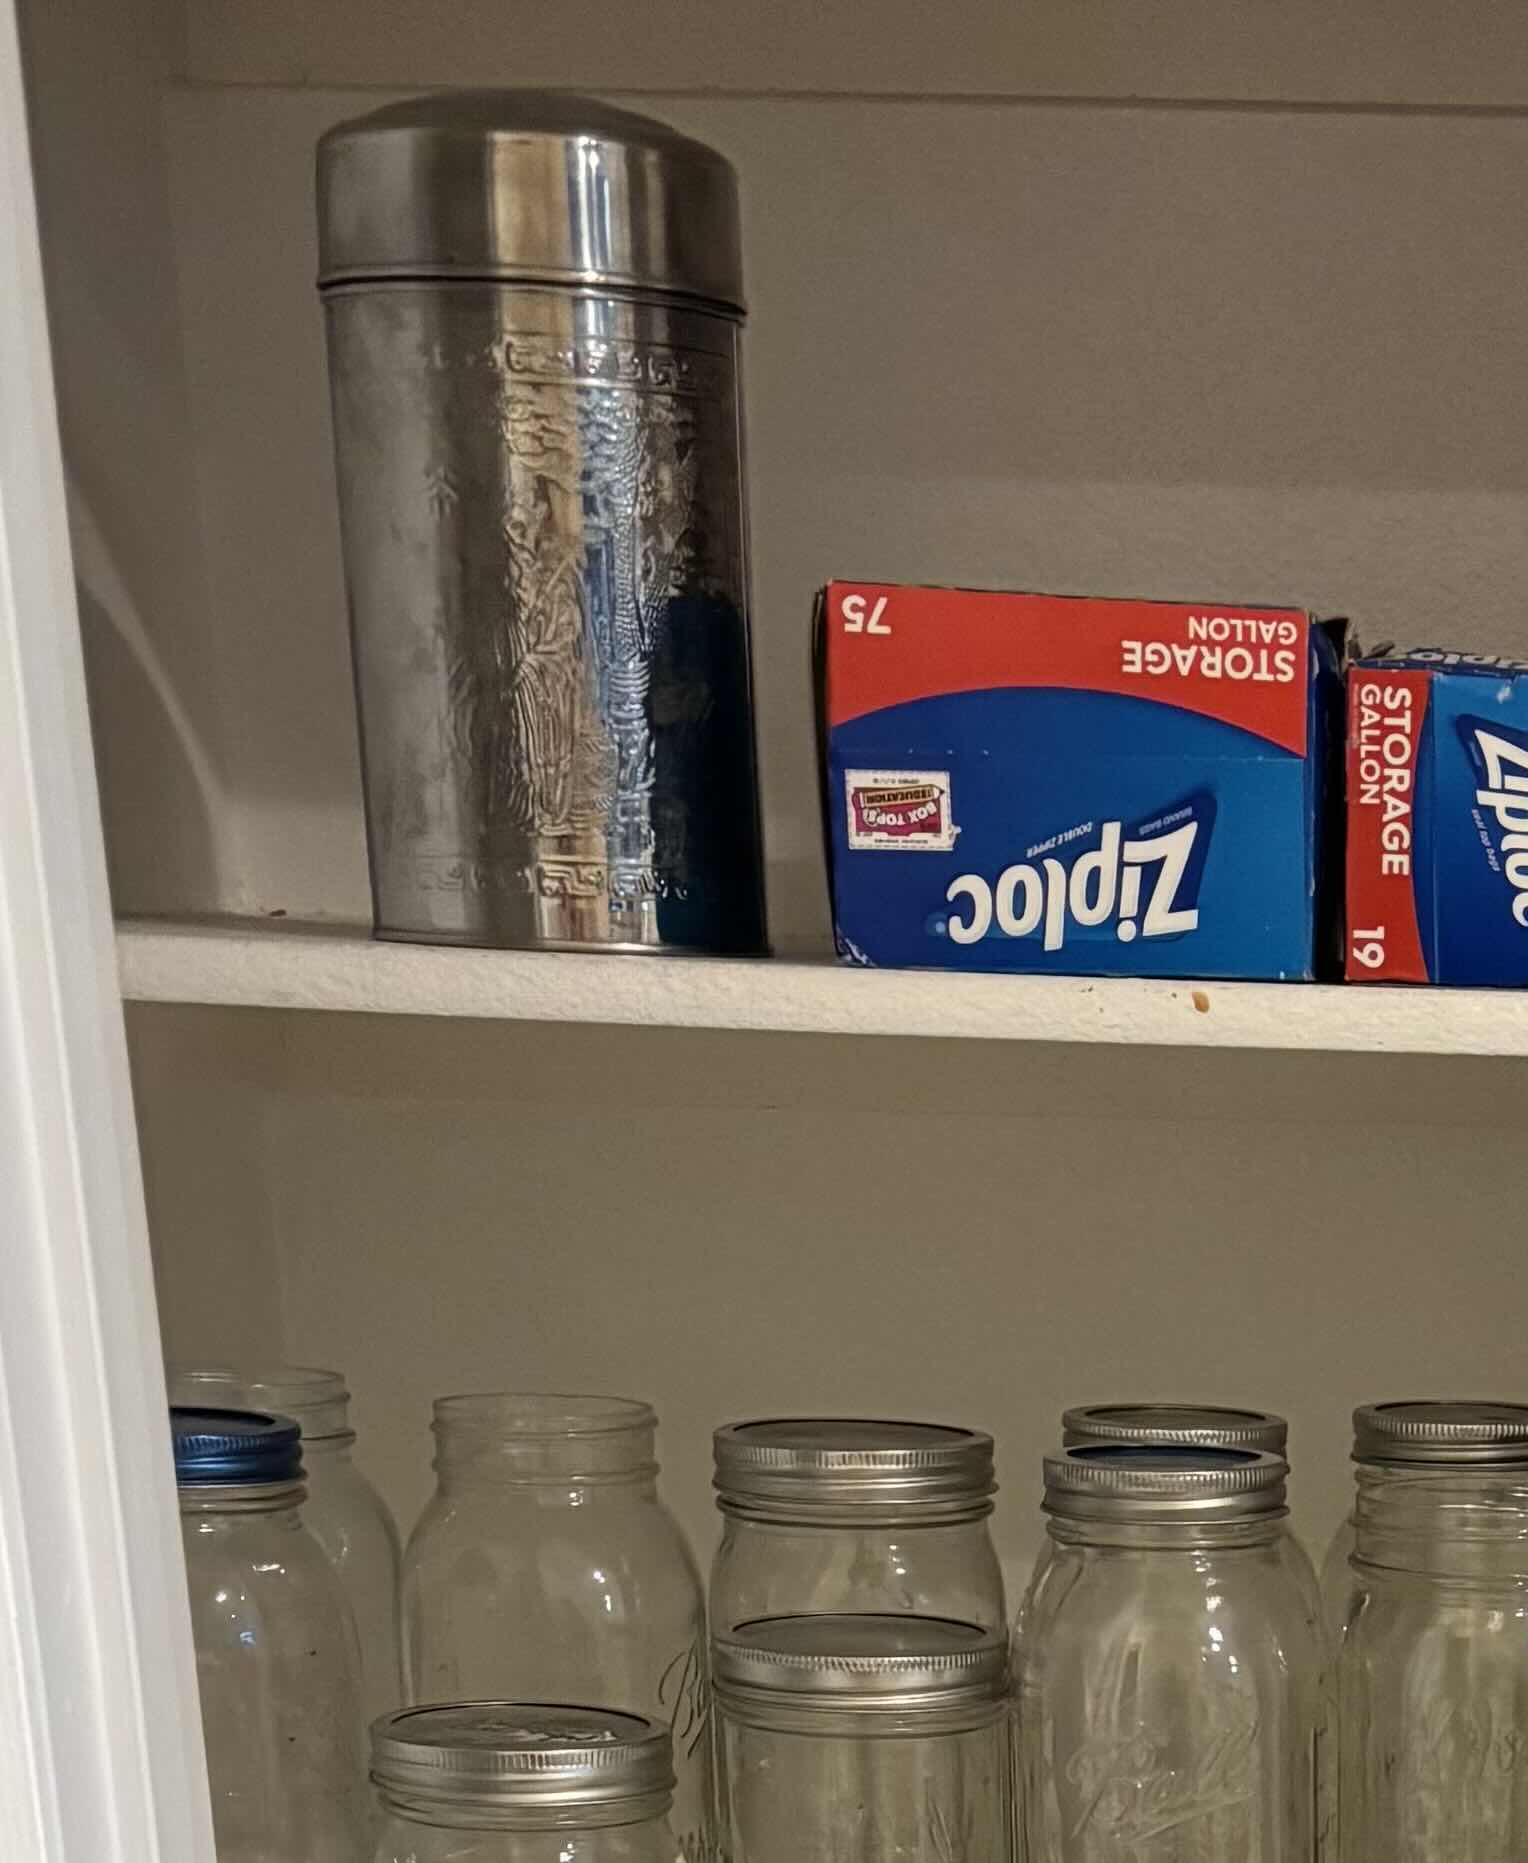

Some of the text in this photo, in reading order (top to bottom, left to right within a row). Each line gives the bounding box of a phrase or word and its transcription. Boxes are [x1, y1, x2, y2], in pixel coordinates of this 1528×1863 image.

[841, 594, 891, 634] 75
[1188, 615, 1297, 645] GALLON
[1121, 638, 1295, 682] STORAGE
[1359, 684, 1382, 805] GALLON
[1382, 685, 1411, 876] STORAGE
[907, 800, 939, 824] BOX
[1025, 820, 1094, 859] DOUBLE ZIPPER
[946, 820, 1200, 952] Ziploc
[1351, 925, 1385, 969] 19
